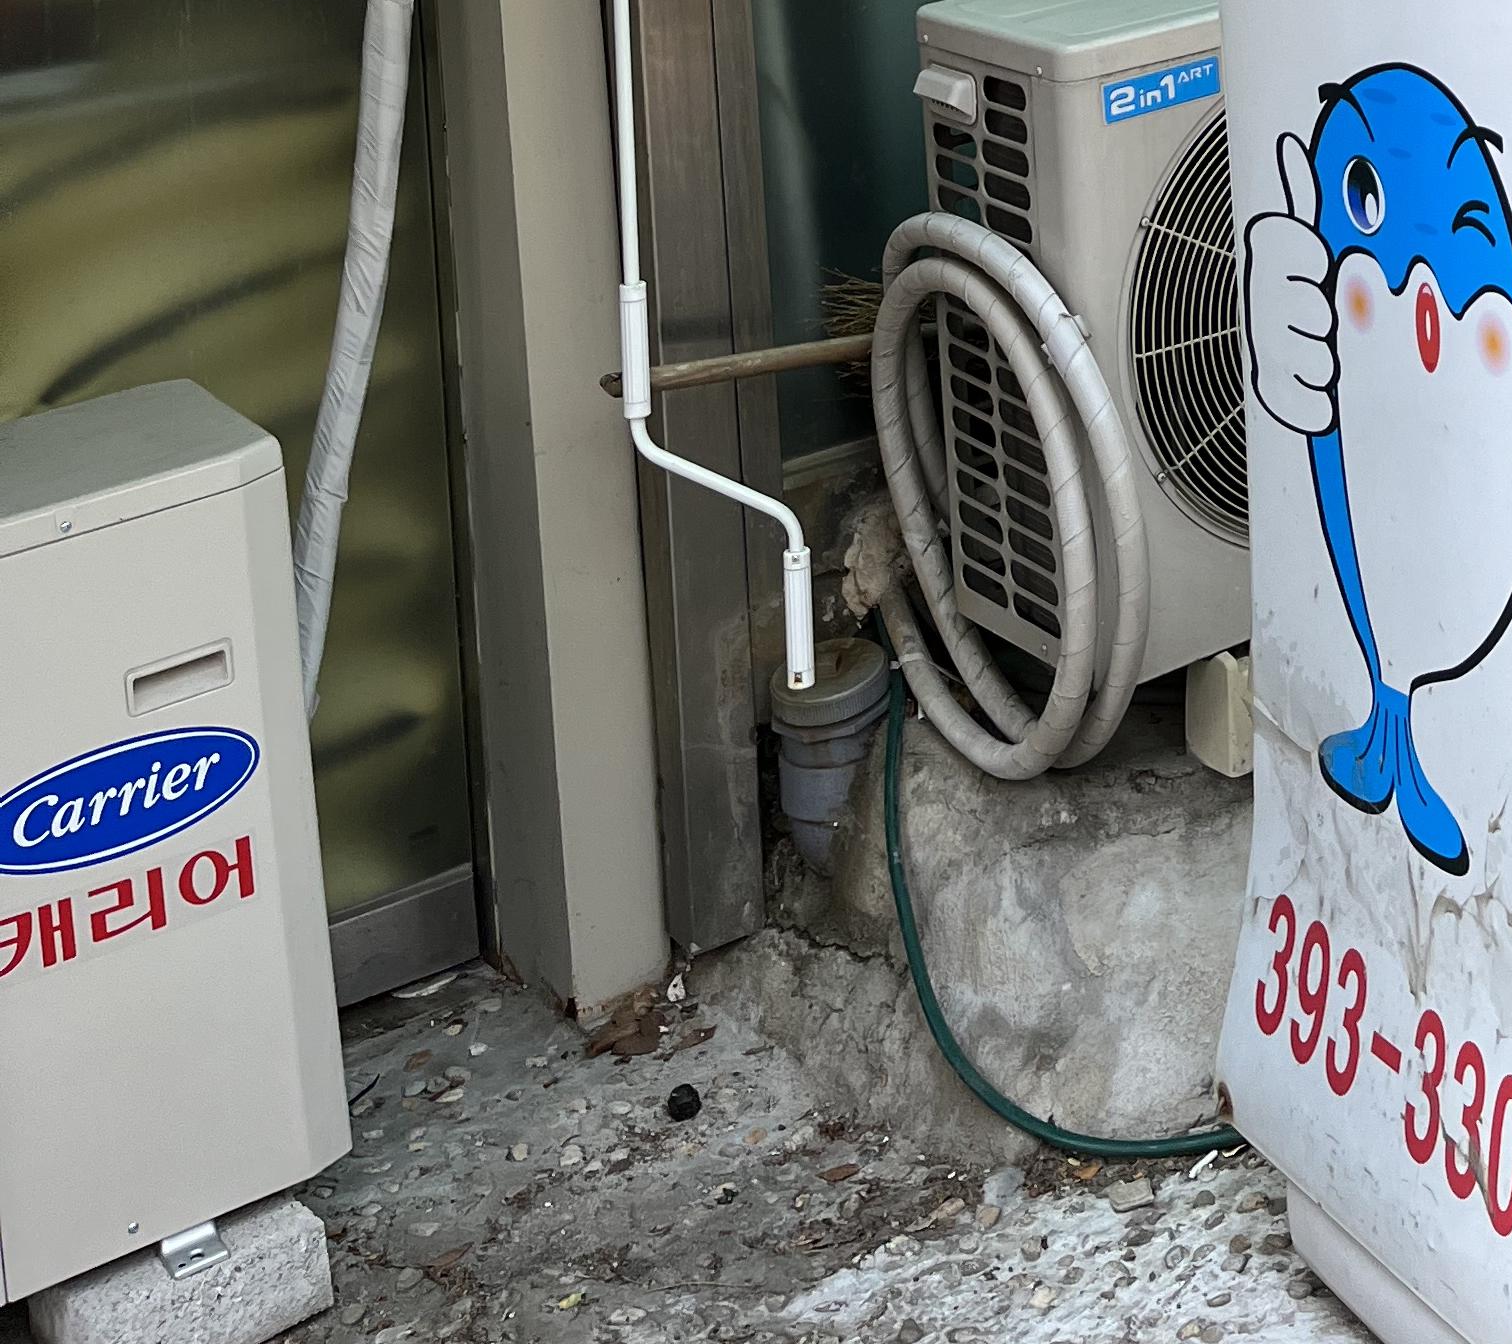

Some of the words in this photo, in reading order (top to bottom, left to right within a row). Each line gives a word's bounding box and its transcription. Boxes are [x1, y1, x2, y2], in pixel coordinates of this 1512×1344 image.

[1177, 63, 1214, 84] ART
[12, 752, 221, 848] Carrier
[0, 835, 256, 978] 캐리어
